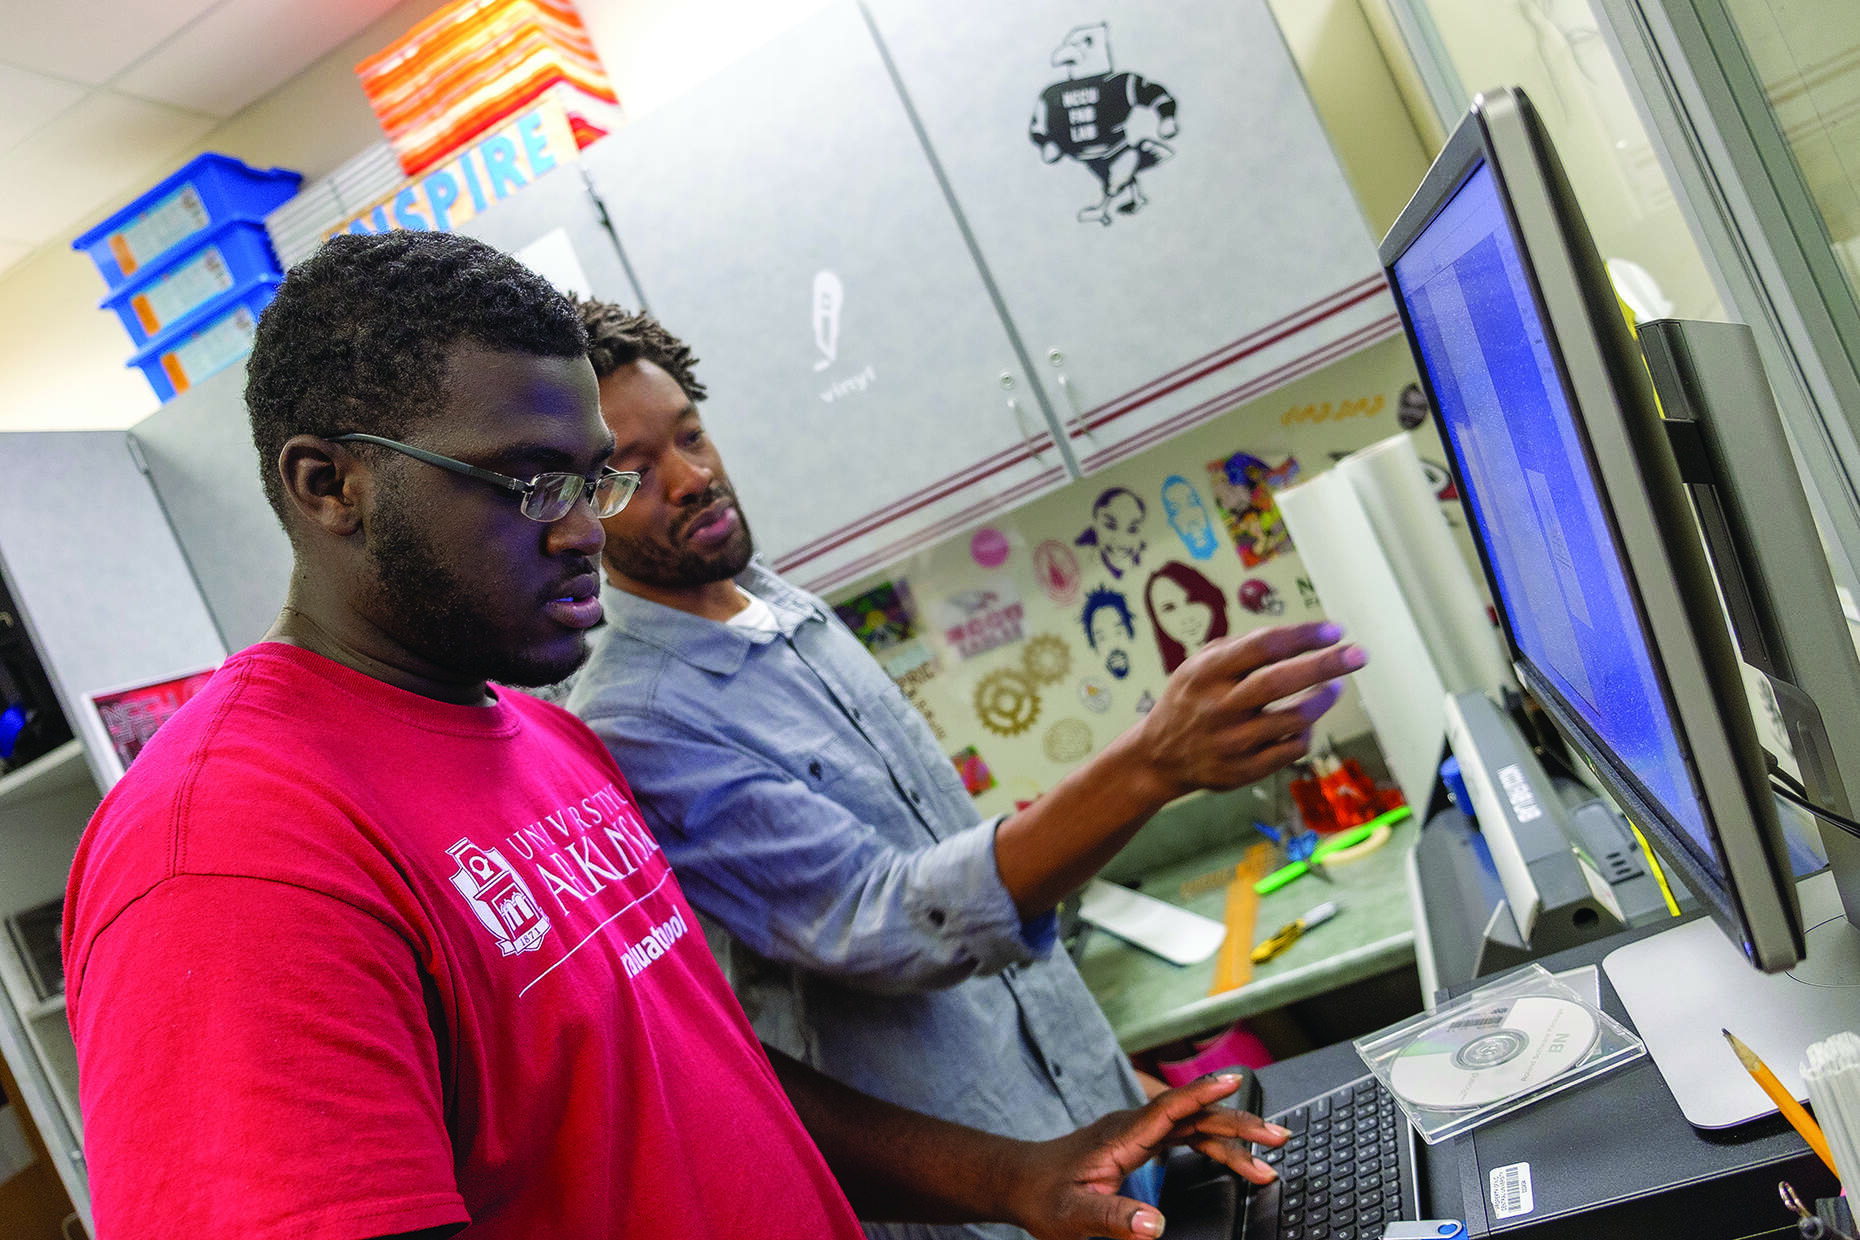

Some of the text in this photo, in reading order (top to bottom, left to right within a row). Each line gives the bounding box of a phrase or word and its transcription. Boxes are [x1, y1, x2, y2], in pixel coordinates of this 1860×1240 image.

[333, 112, 557, 233] NSPIRE
[818, 365, 877, 403] vinyl
[519, 927, 541, 947] 1871
[1548, 1033, 1571, 1053] BN
